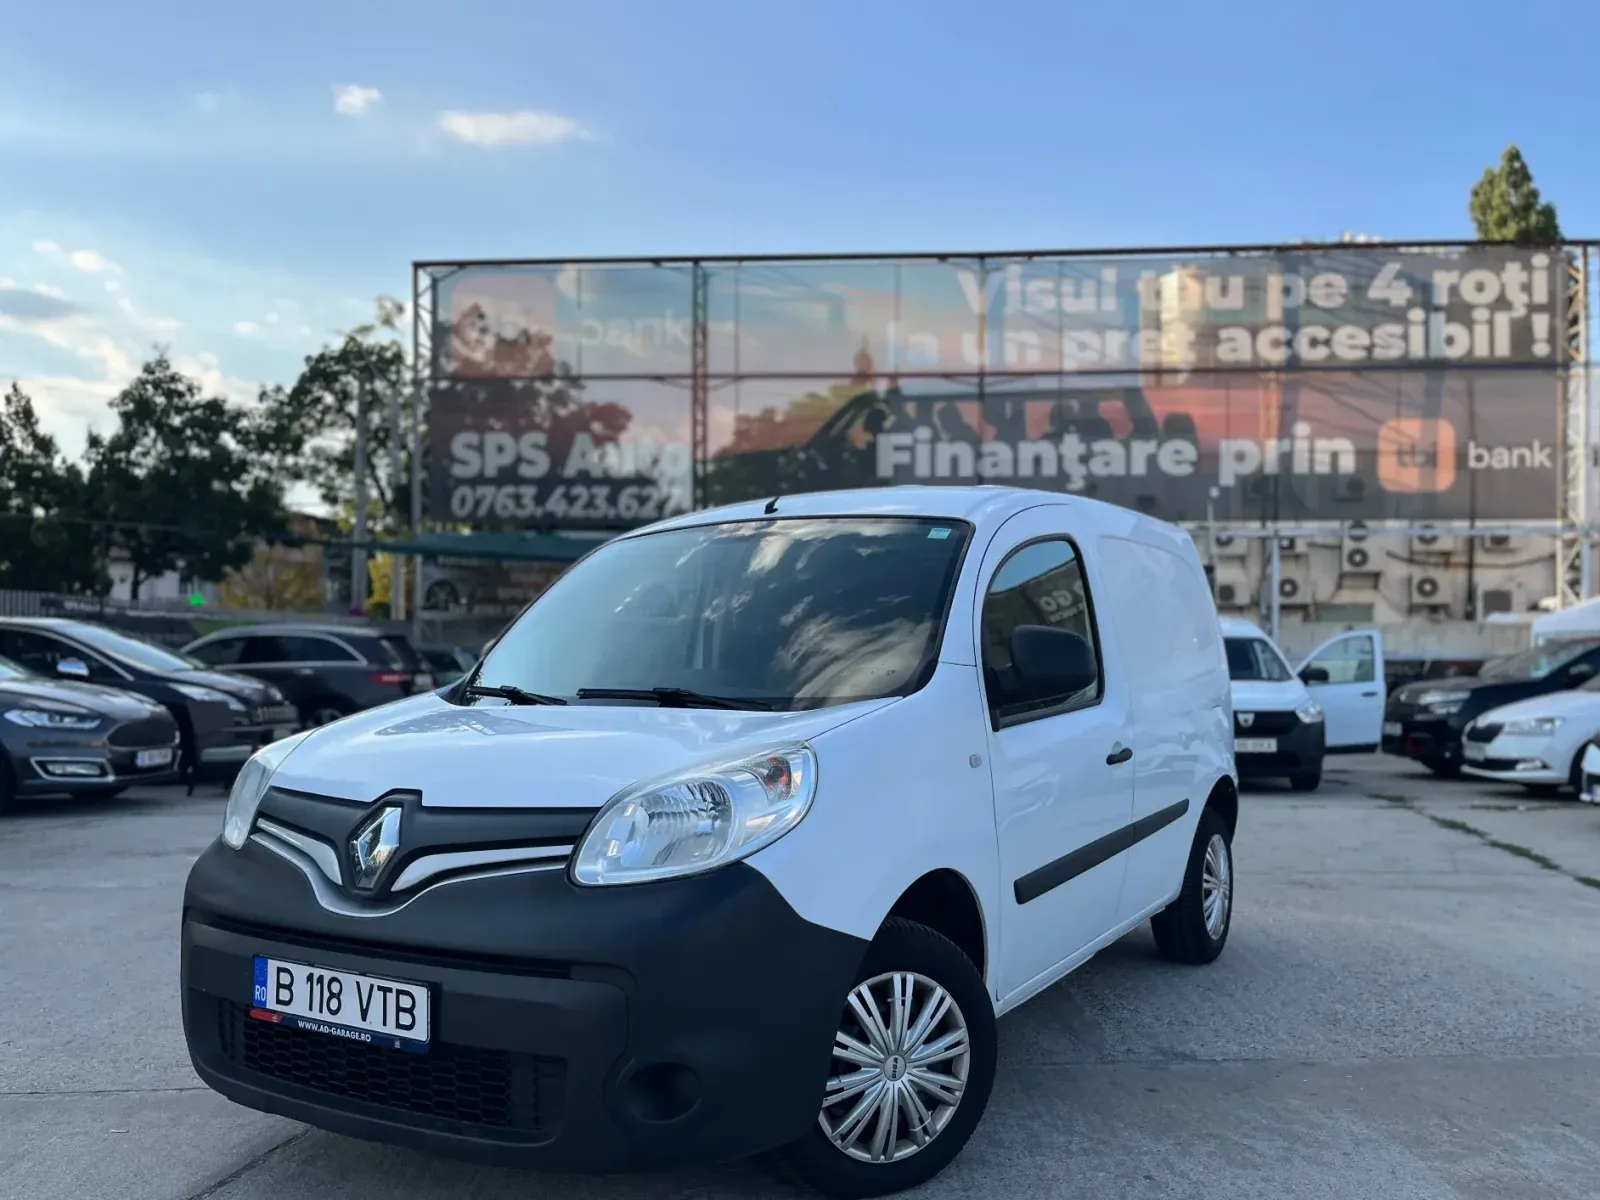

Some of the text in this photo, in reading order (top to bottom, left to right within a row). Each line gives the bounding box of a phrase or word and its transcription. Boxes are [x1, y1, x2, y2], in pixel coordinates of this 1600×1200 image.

[956, 264, 1118, 316] Visul
[1266, 271, 1349, 320] pe
[1367, 262, 1414, 306] 4
[1216, 306, 1512, 362] accesibil
[451, 430, 551, 479] SPS
[1218, 421, 1356, 487] prin
[1467, 439, 1553, 470] bank
[255, 966, 417, 1032] RO B 118 VTB
[297, 1019, 372, 1043] WWW.AD-GARAGE.RO
